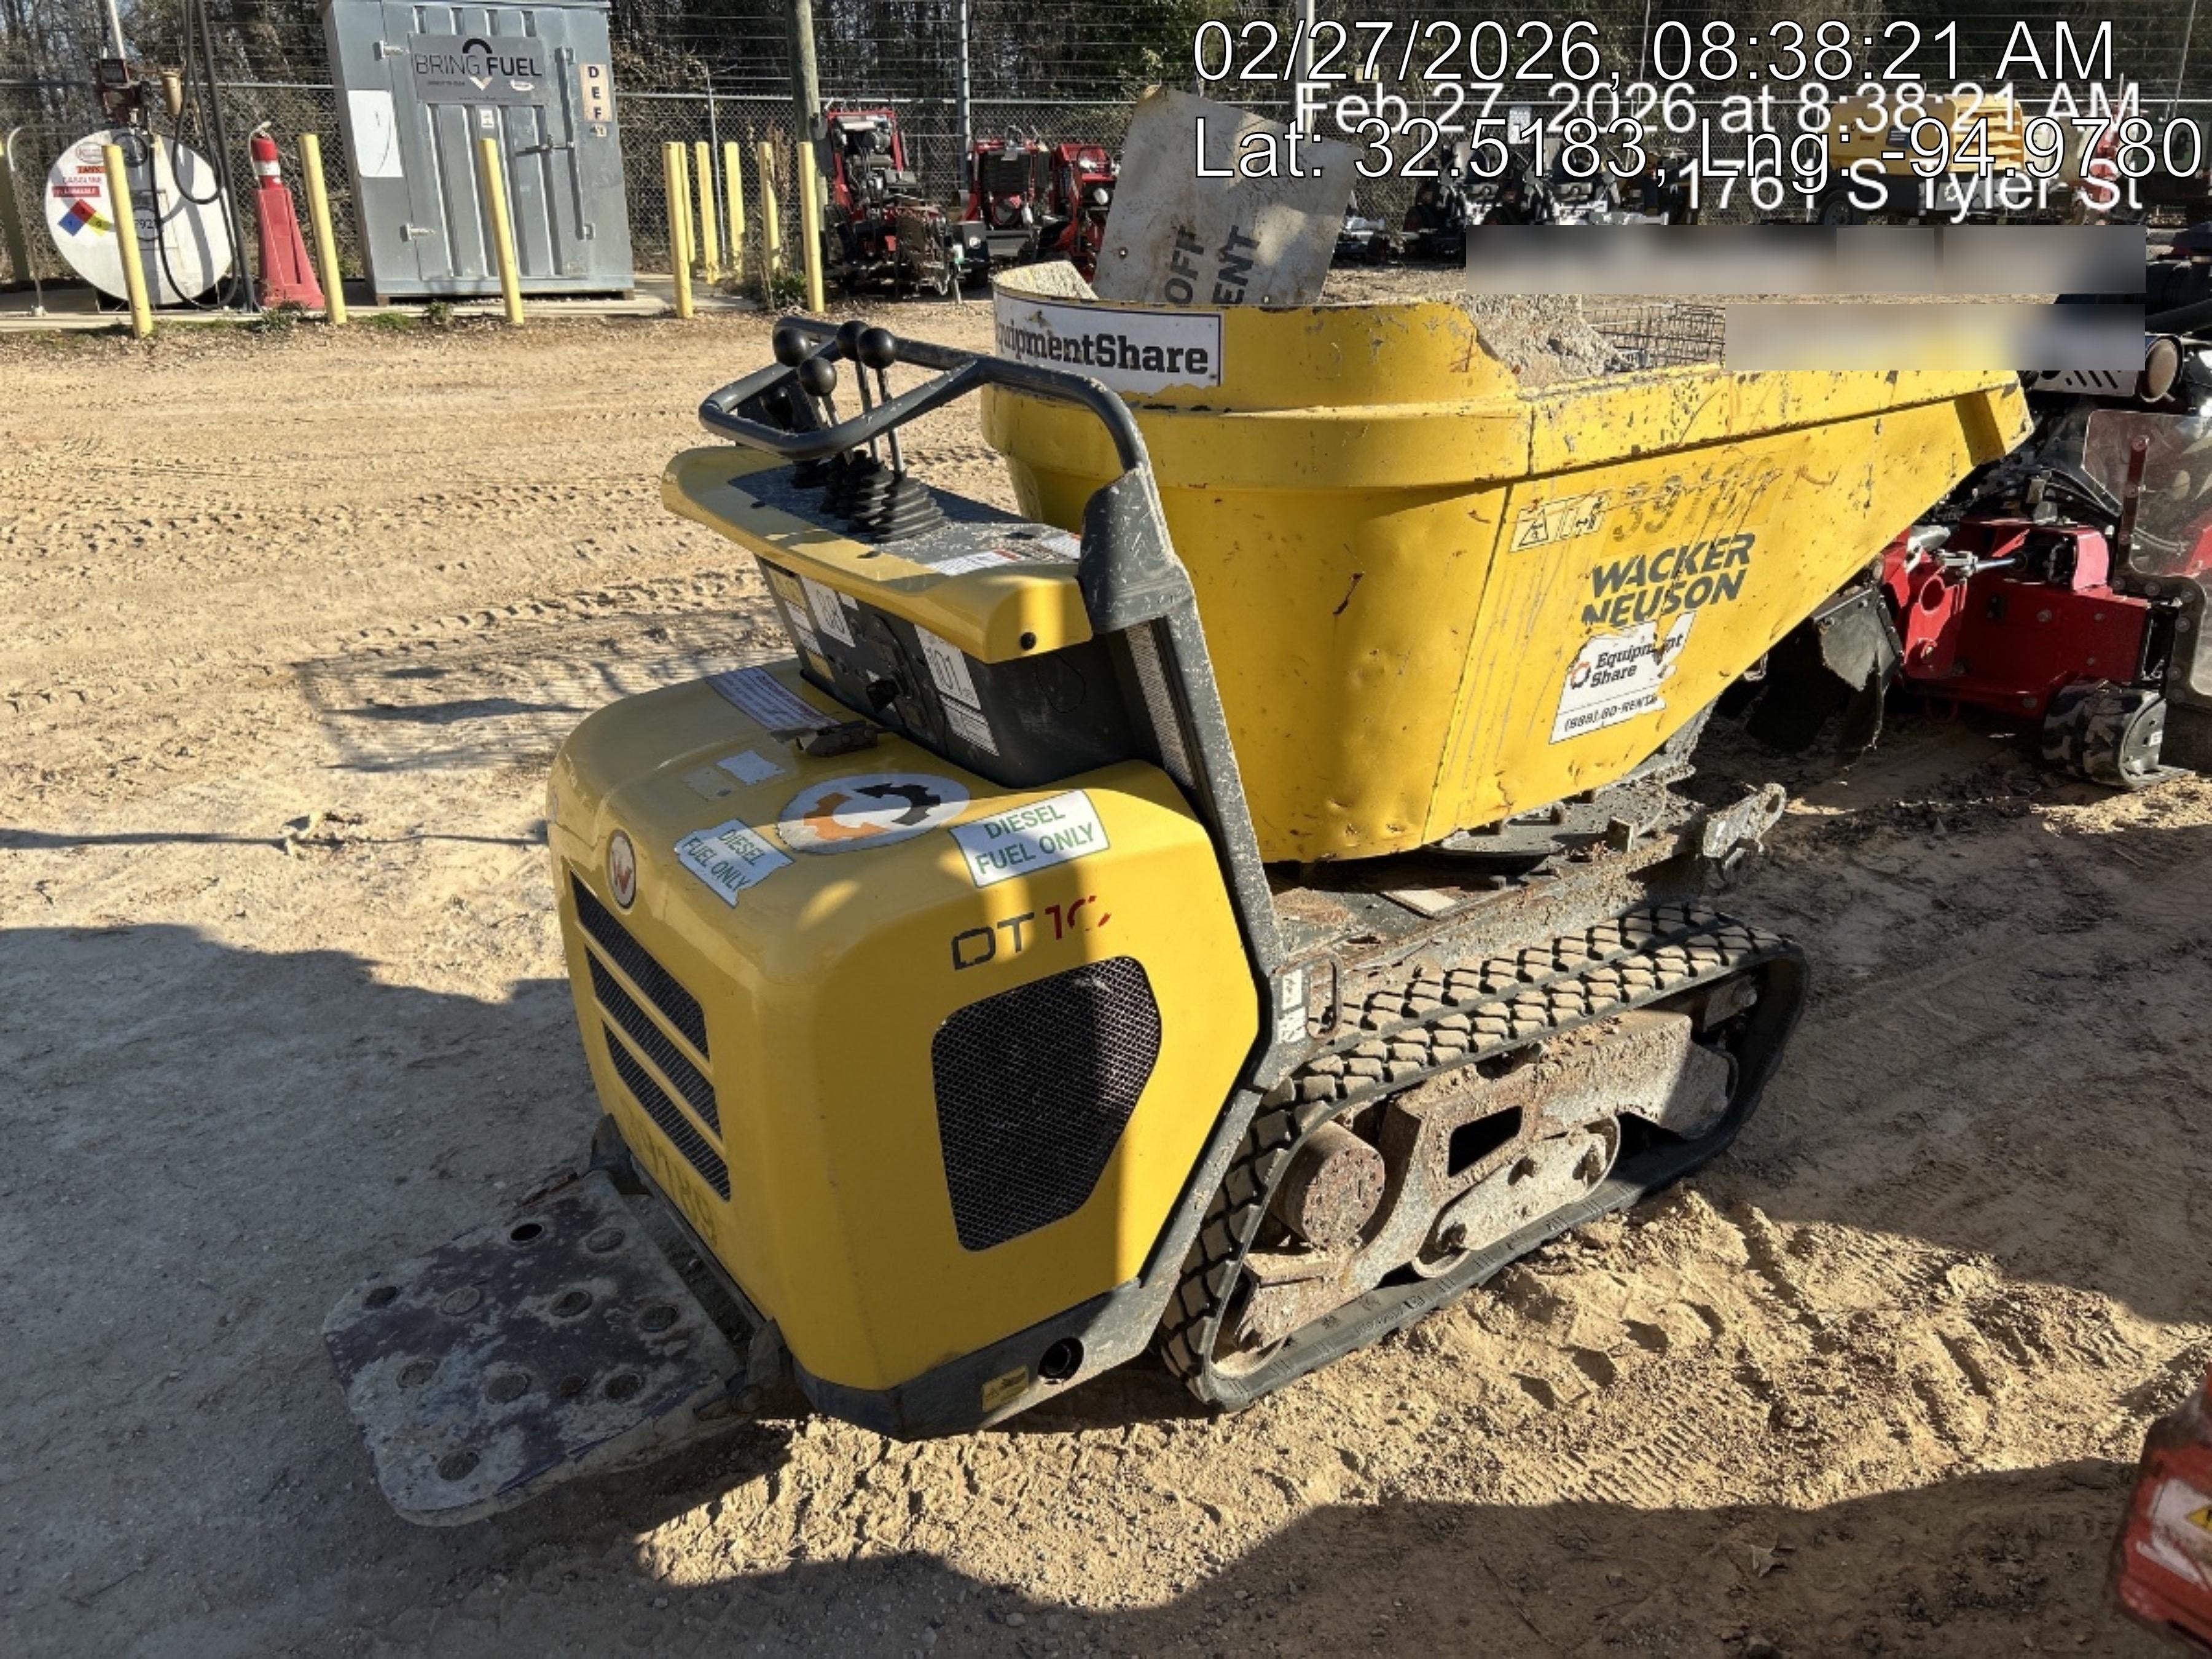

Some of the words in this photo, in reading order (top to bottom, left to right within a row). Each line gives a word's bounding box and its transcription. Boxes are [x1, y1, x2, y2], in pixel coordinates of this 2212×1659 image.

[415, 55, 479, 74] BRING
[487, 57, 542, 77] FUEL
[996, 321, 1209, 375] quipmentShare
[1591, 533, 1755, 598] WACKER
[1581, 568, 1747, 627] NEUSON
[1590, 665, 1637, 688] Share
[718, 829, 766, 866] DIESEL
[983, 804, 1066, 839] DIESEL
[681, 836, 717, 868] FUEL
[711, 860, 751, 892] ONLY
[975, 842, 1037, 874] FUEL
[1038, 822, 1094, 854] ONLY
